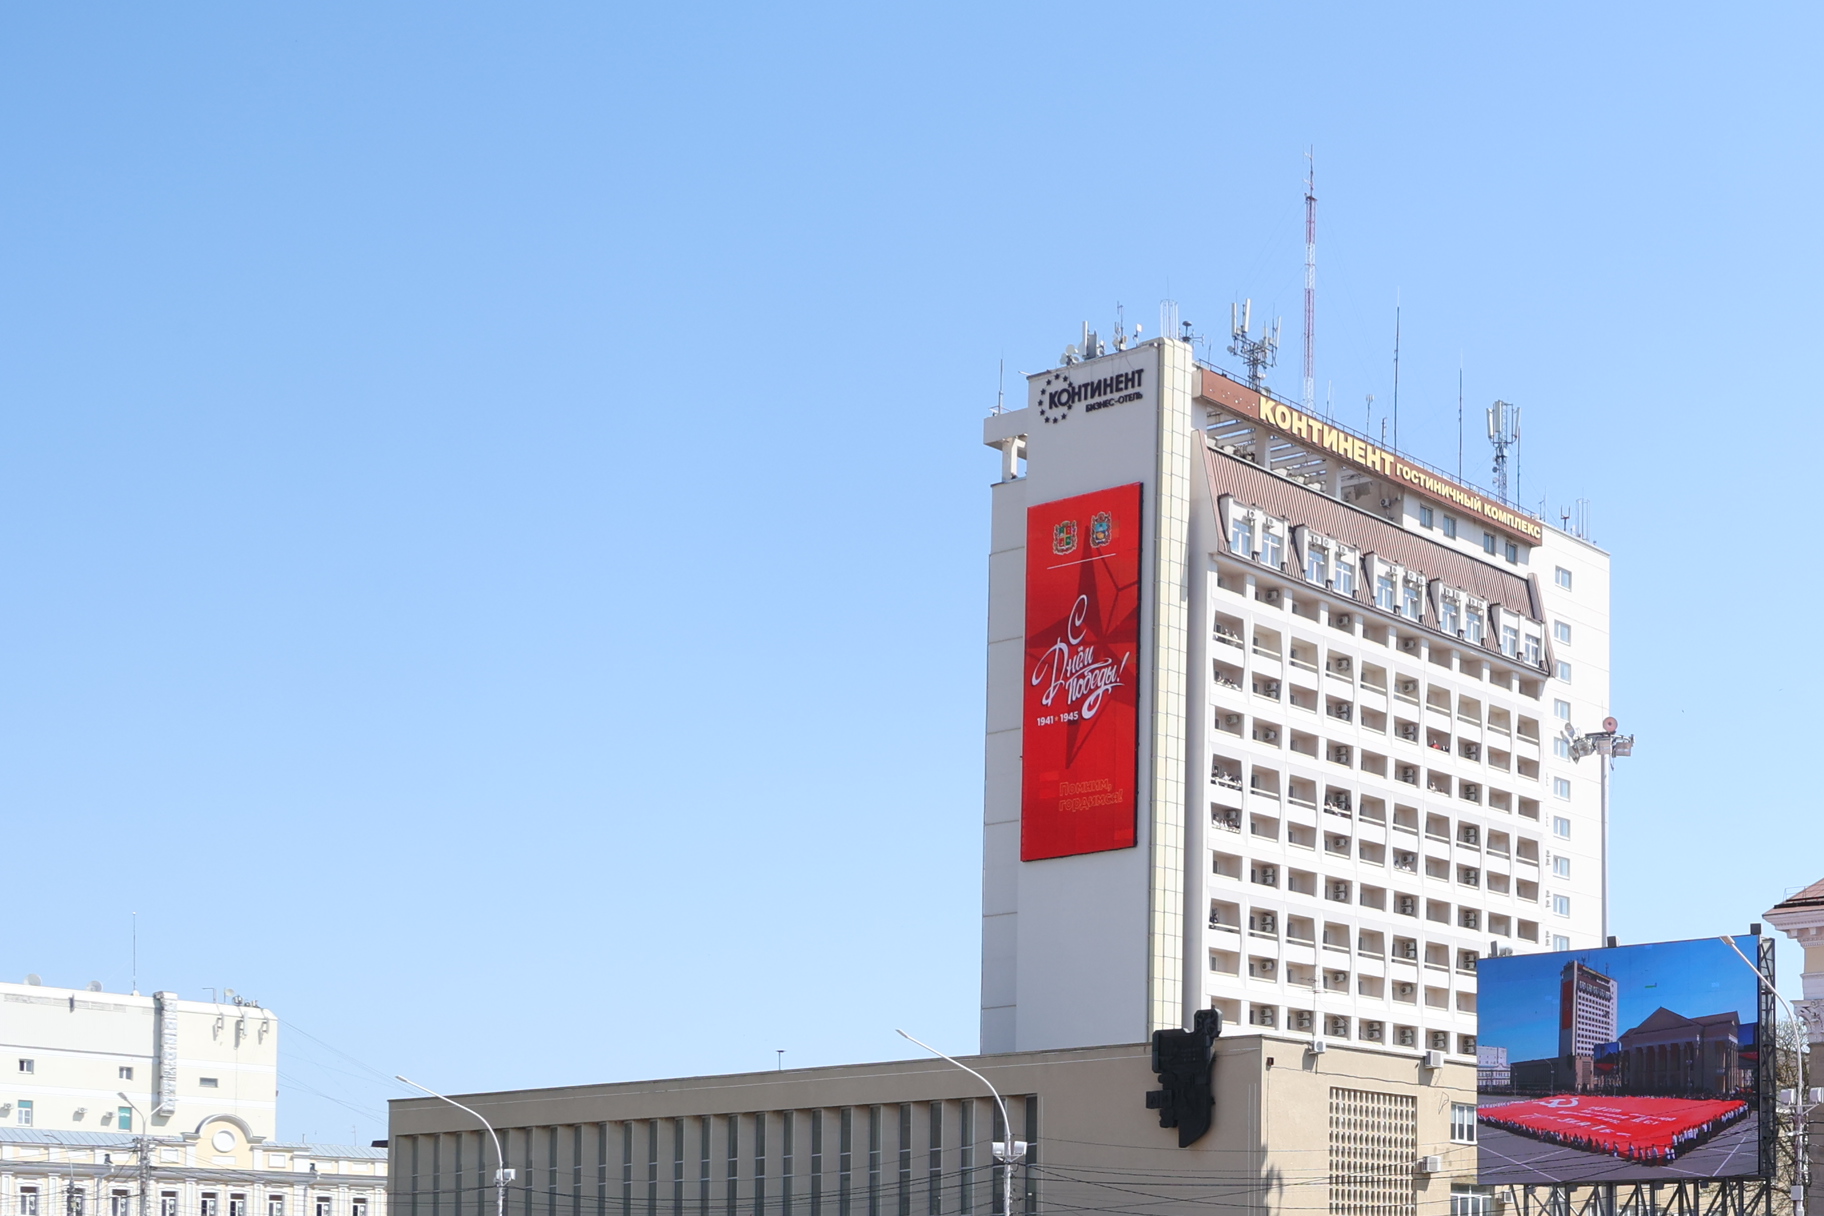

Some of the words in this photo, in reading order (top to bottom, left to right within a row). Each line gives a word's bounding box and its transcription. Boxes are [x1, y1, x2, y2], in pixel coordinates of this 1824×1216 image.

[1048, 369, 1144, 410] КОНТИНЕНТ
[1085, 391, 1143, 412] БИЗНЕС-ОТЕЛЬ
[1259, 396, 1395, 476] КОНТИНЕНТ
[1396, 462, 1482, 514] ГОСТИНИЧНЫЙ
[1483, 503, 1541, 539] КОМПЛЕКС
[1067, 594, 1088, 645] С
[1065, 651, 1130, 719] Победы!
[1037, 715, 1054, 726] 1941
[1060, 711, 1079, 722] 1945
[1059, 778, 1112, 797] Помним,
[1059, 788, 1123, 812] гордимся!
